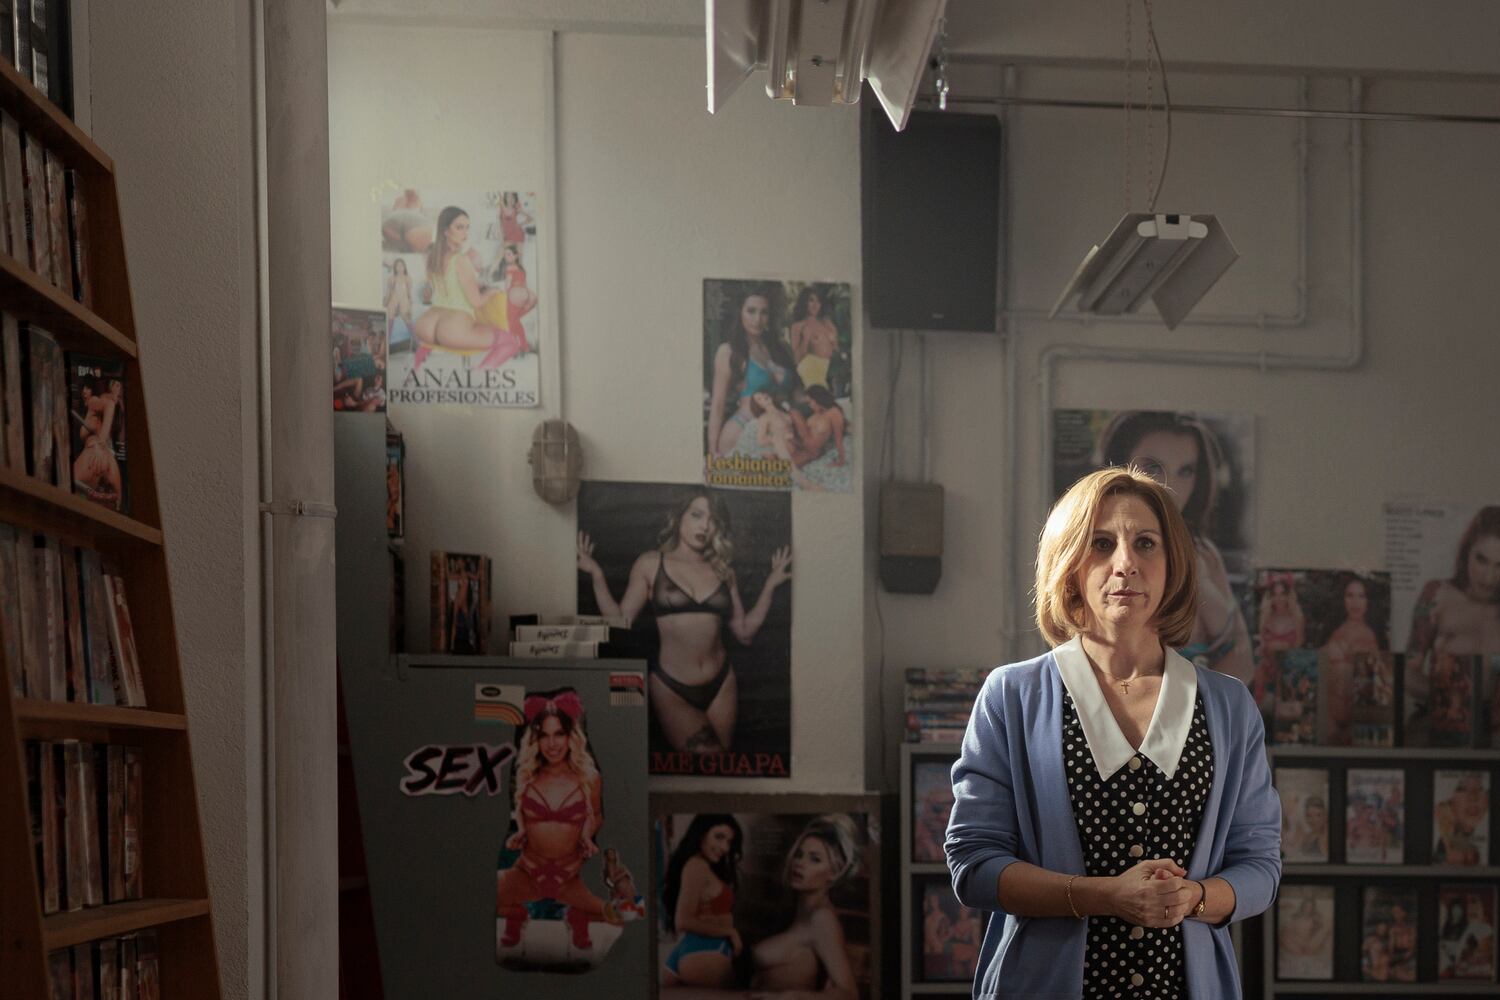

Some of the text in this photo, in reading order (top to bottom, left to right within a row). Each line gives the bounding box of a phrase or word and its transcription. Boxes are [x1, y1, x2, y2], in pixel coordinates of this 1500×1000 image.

[403, 368, 517, 389] ANALES
[389, 388, 537, 405] PROFESIONALES
[706, 452, 792, 472] Lesbianas
[405, 747, 512, 793] SEX
[697, 751, 787, 776] GUAPA
